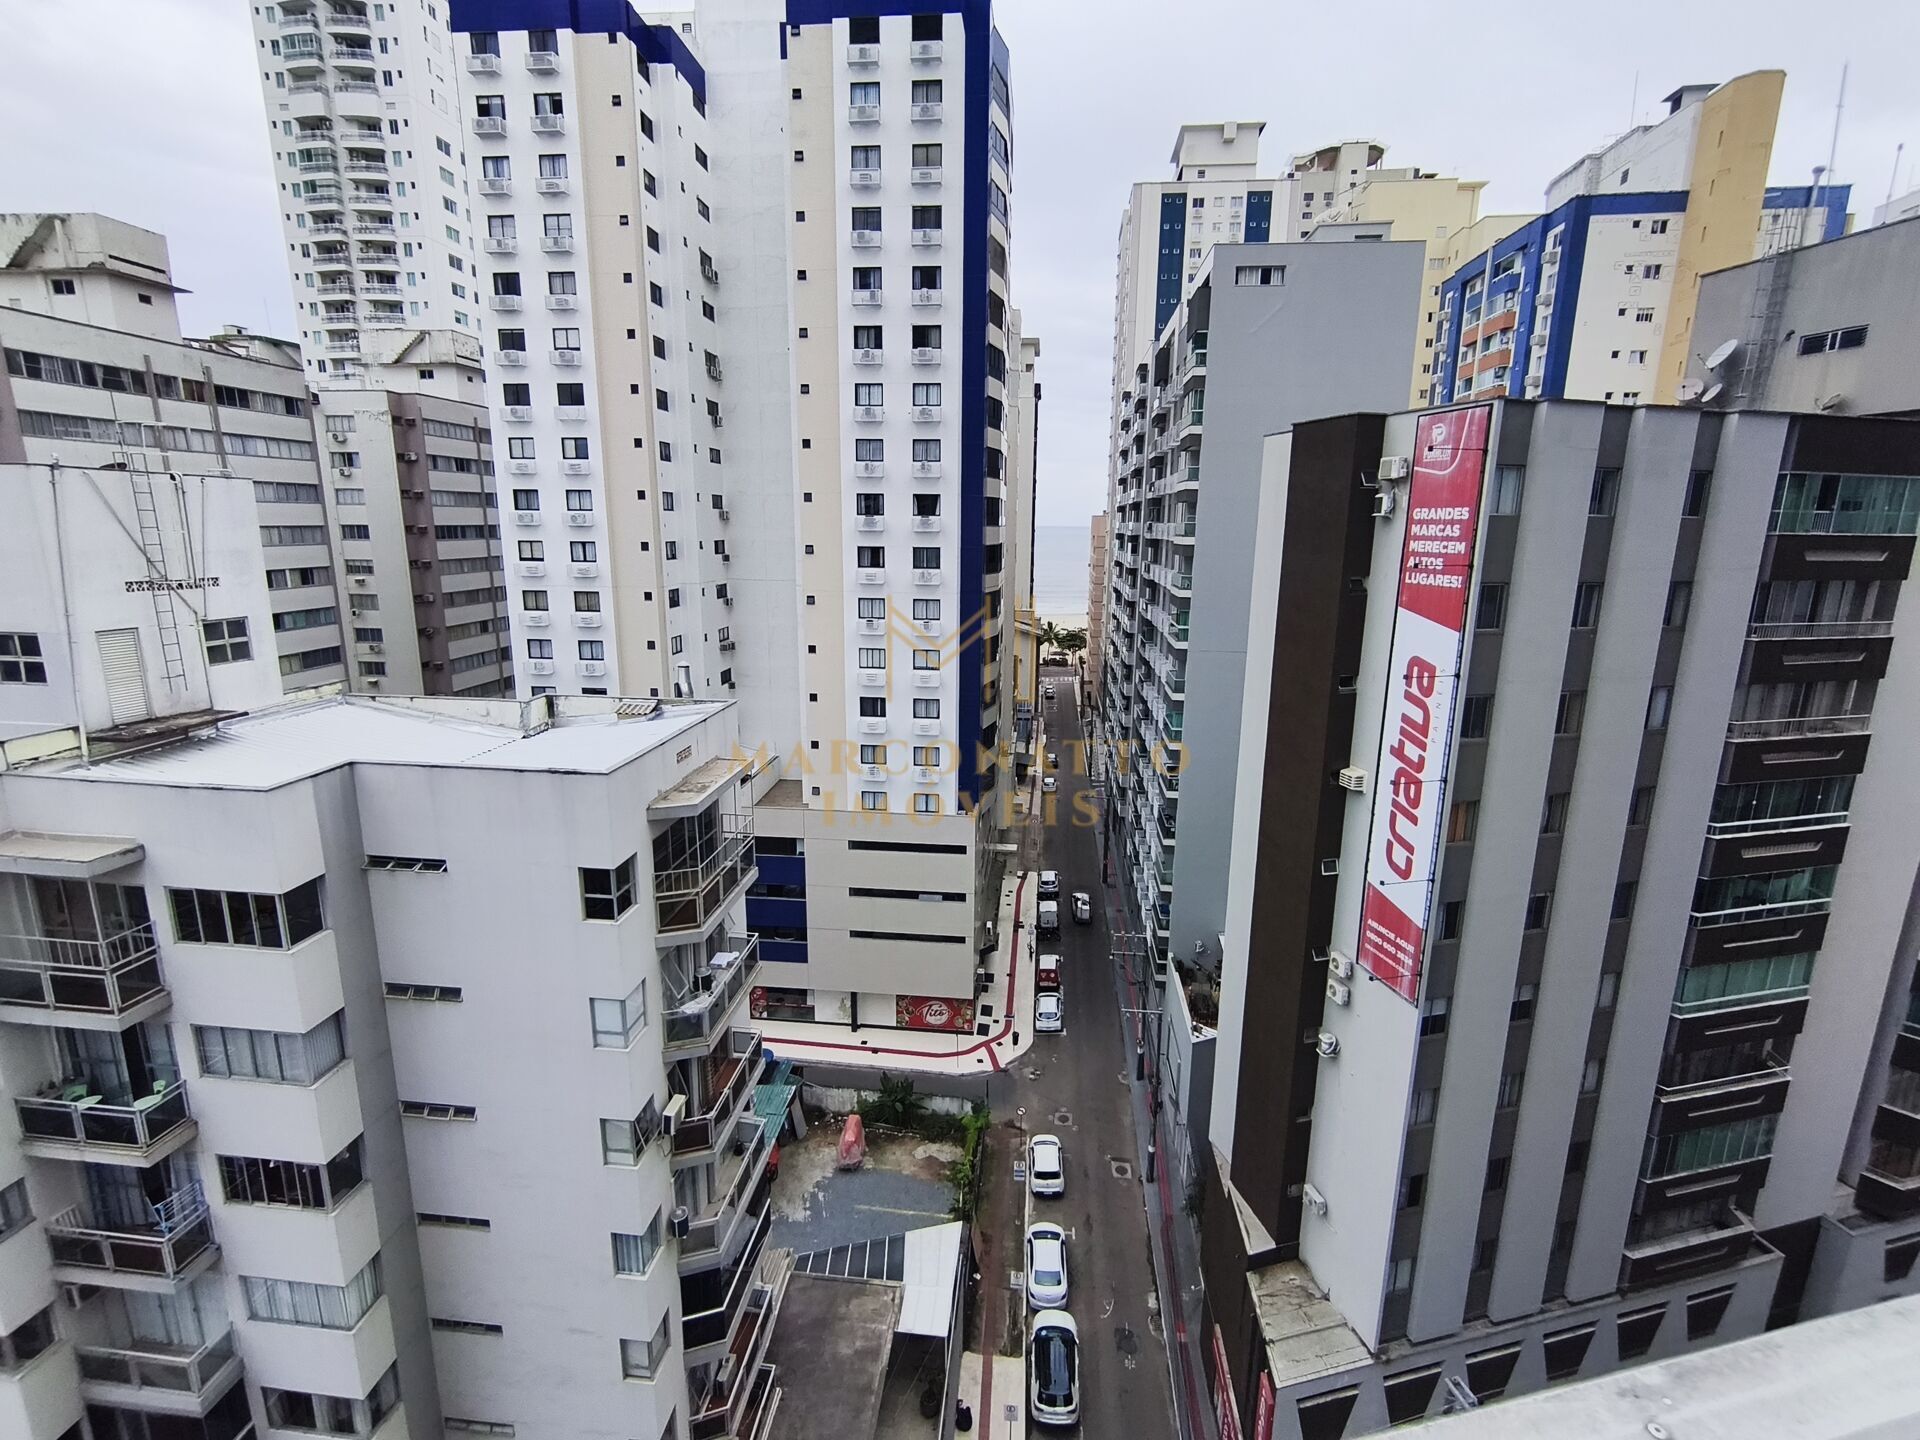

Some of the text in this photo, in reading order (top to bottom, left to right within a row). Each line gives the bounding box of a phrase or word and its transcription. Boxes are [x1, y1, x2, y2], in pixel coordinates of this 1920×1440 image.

[1412, 507, 1470, 520] GRANDES
[1410, 524, 1461, 537] MARCAS
[1408, 540, 1466, 554] MERECEM
[1404, 571, 1462, 588] LUGARES!
